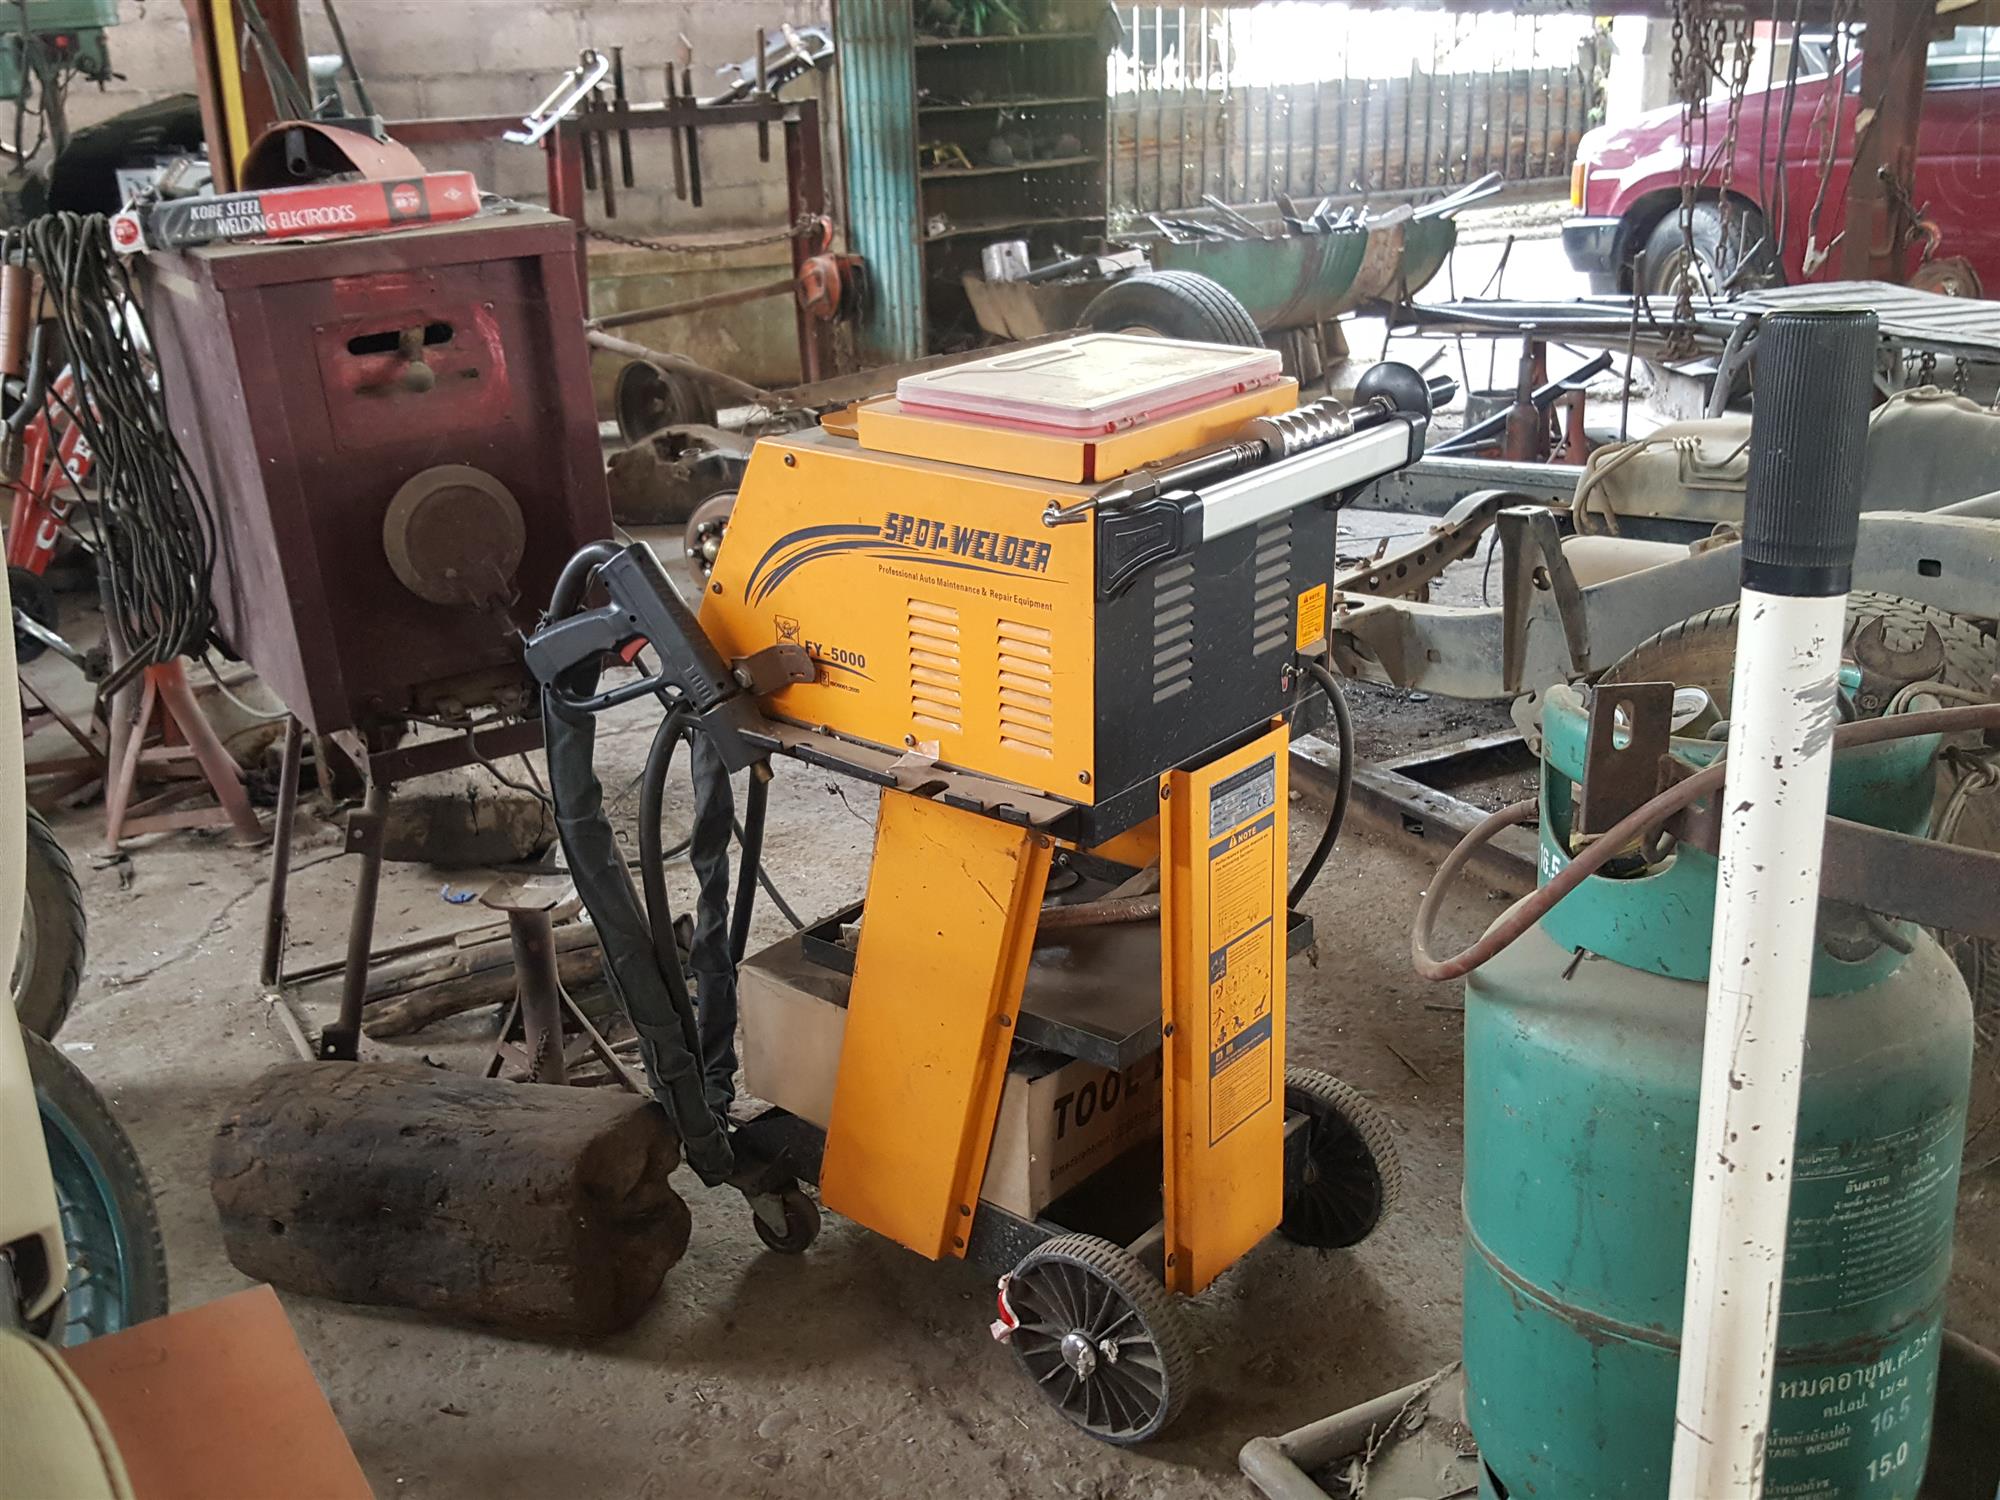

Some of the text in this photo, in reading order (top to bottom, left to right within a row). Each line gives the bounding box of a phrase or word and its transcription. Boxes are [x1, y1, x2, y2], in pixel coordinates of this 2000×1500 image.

[190, 199, 261, 220] KOBE STEEL
[215, 204, 356, 237] WELDING ELECTRODES
[882, 511, 1052, 573] SPOT-WELDER
[878, 564, 1053, 611] Professional Auto Maintenance & Repair Equipment
[804, 640, 866, 669] FY-5000
[1238, 826, 1257, 843] NOTE
[1870, 1394, 1911, 1437] 16.5
[1866, 1441, 1908, 1482] 15.0
